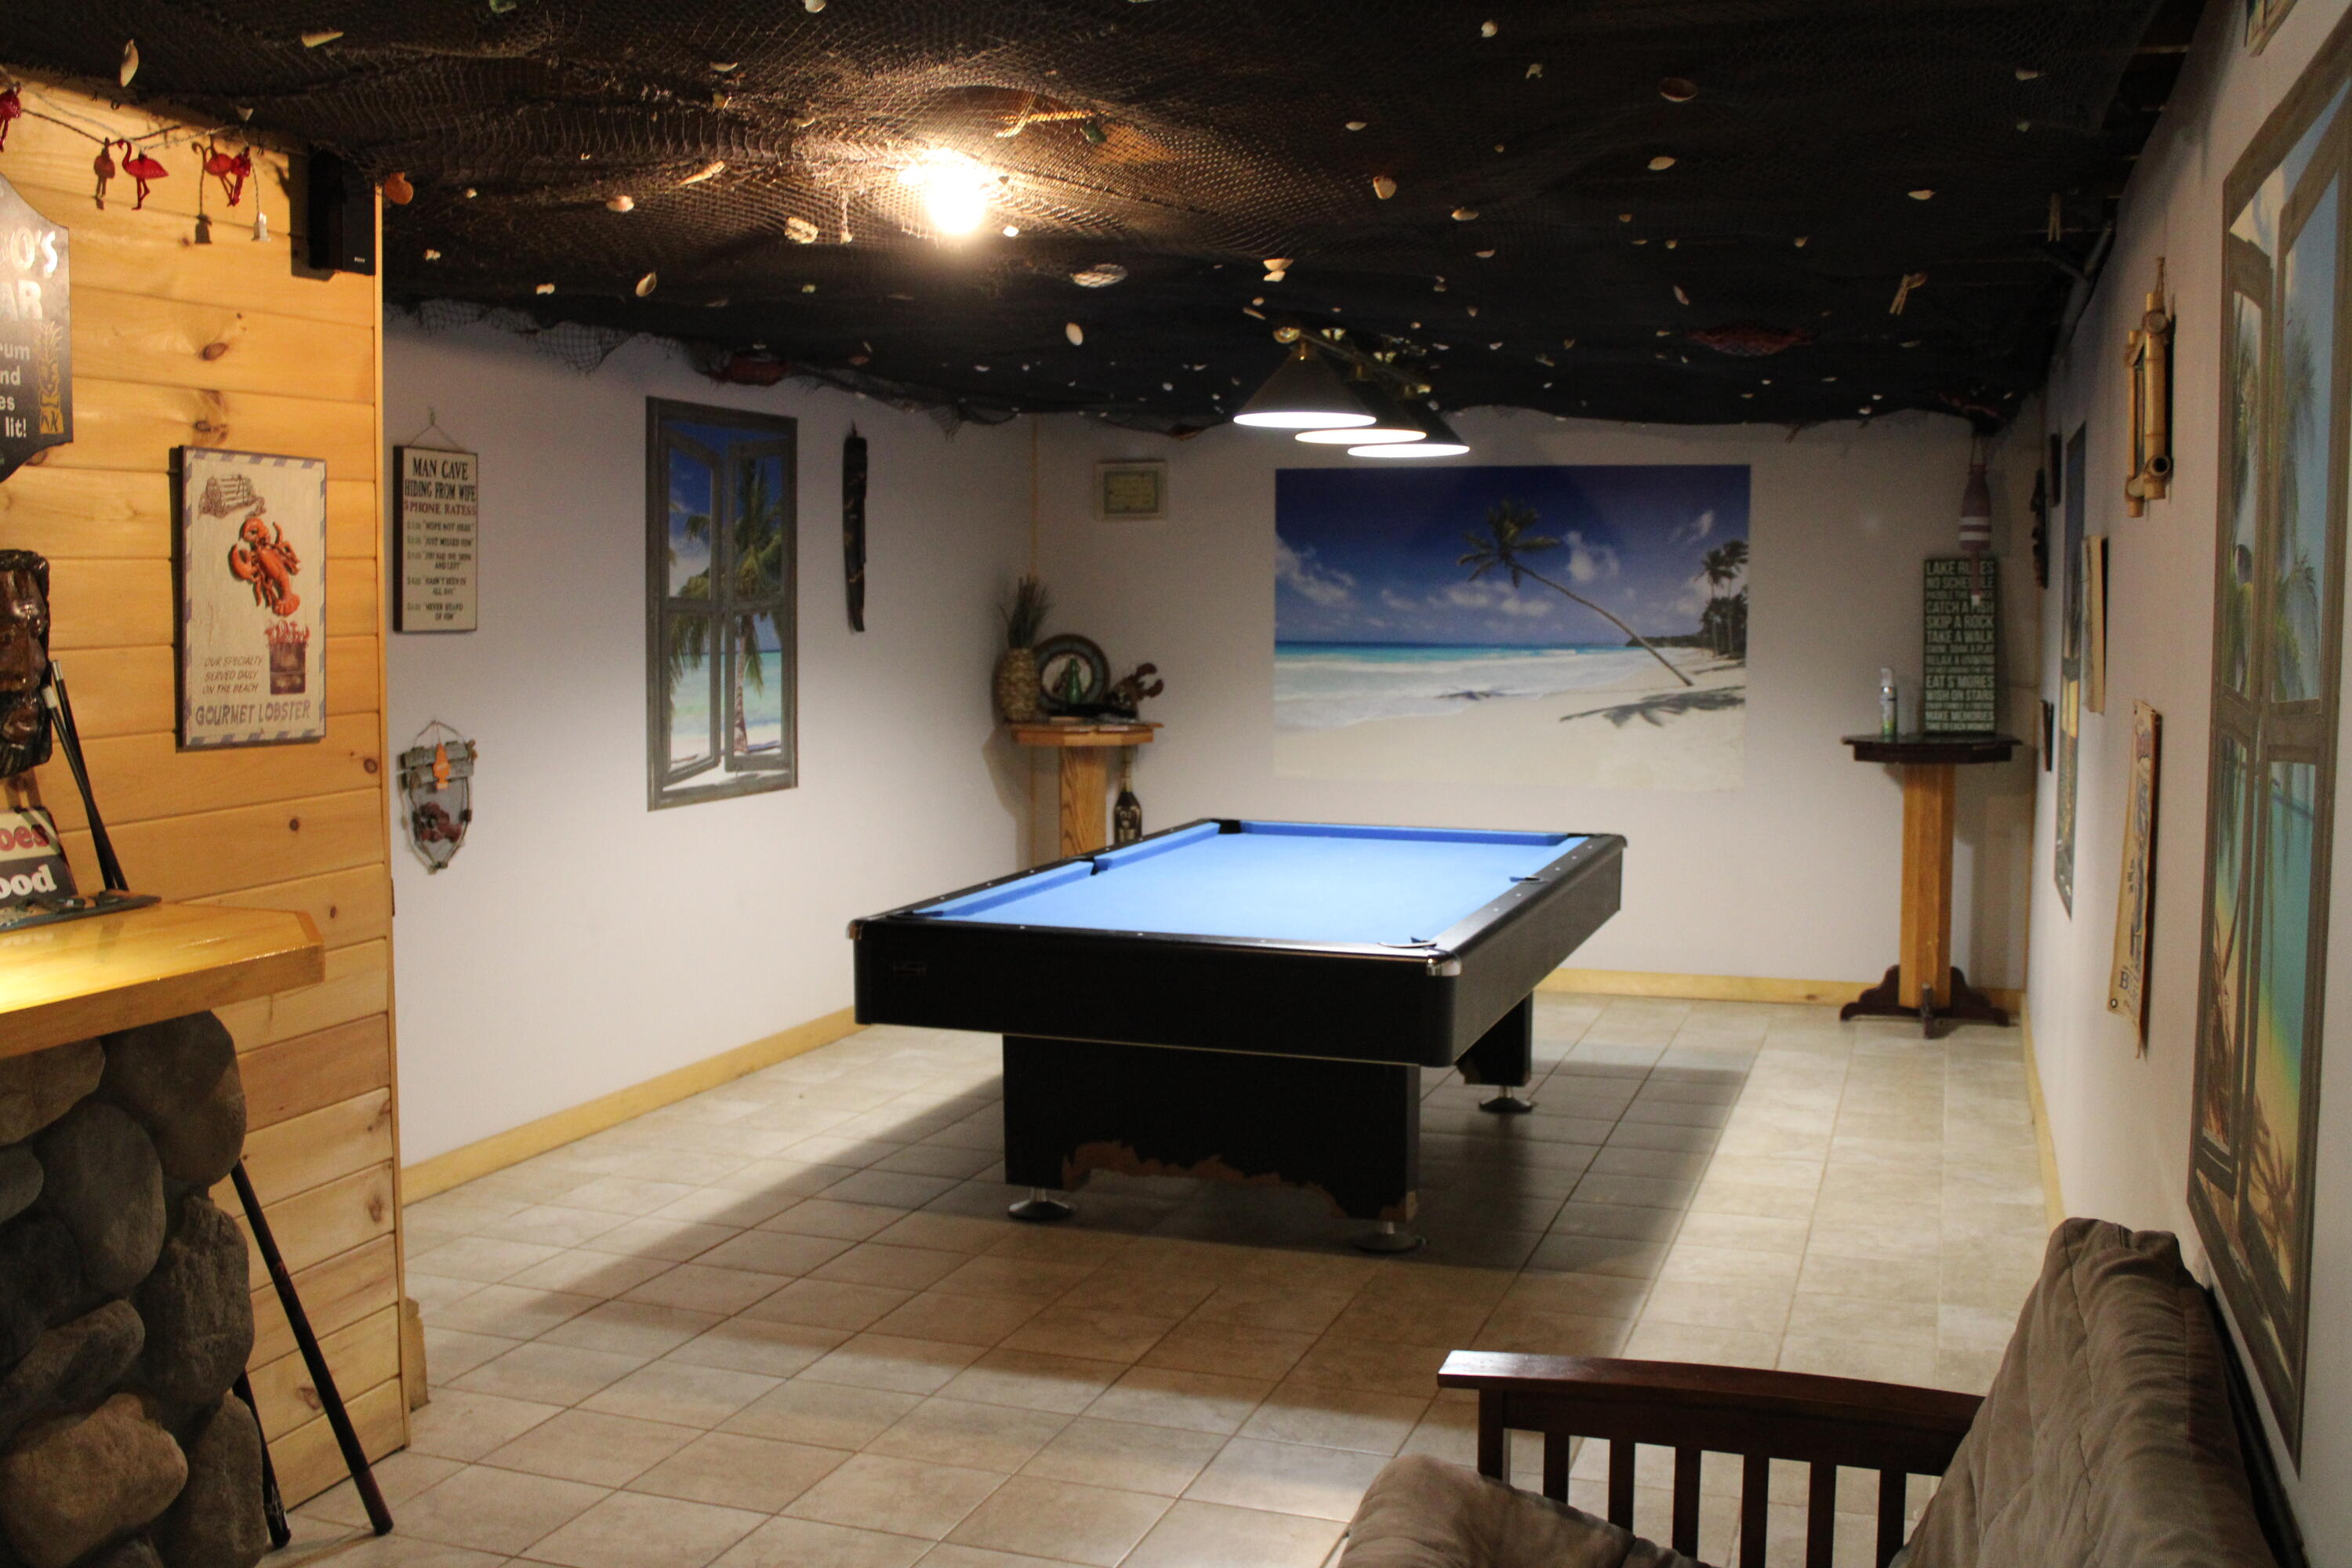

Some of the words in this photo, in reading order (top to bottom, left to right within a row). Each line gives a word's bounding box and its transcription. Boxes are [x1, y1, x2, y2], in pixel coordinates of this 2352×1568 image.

[5, 416, 27, 438] lit!
[412, 458, 437, 477] MAN
[441, 460, 468, 481] CAVE
[405, 479, 432, 498] HIDING
[435, 481, 456, 499] FROM
[459, 484, 476, 502] WIFE
[1926, 561, 1955, 575] LAKE
[1926, 601, 1959, 614] CATCH
[1962, 601, 1969, 614] A
[1926, 615, 1952, 628] SKIP
[1954, 615, 1962, 628] A
[1964, 615, 1994, 628] ROCK
[1927, 630, 1951, 643] TAKE
[1955, 630, 1962, 643] A
[204, 657, 222, 667] OUR
[224, 655, 264, 666] SPECIALTY
[205, 670, 236, 682] SERVED
[238, 670, 259, 680] DAILY
[1926, 675, 1944, 688] EAT
[202, 684, 216, 695] ON
[216, 684, 230, 693] THE
[233, 683, 259, 693] BEACH
[195, 704, 256, 726] GOURMET
[258, 699, 311, 723] LOBSTER
